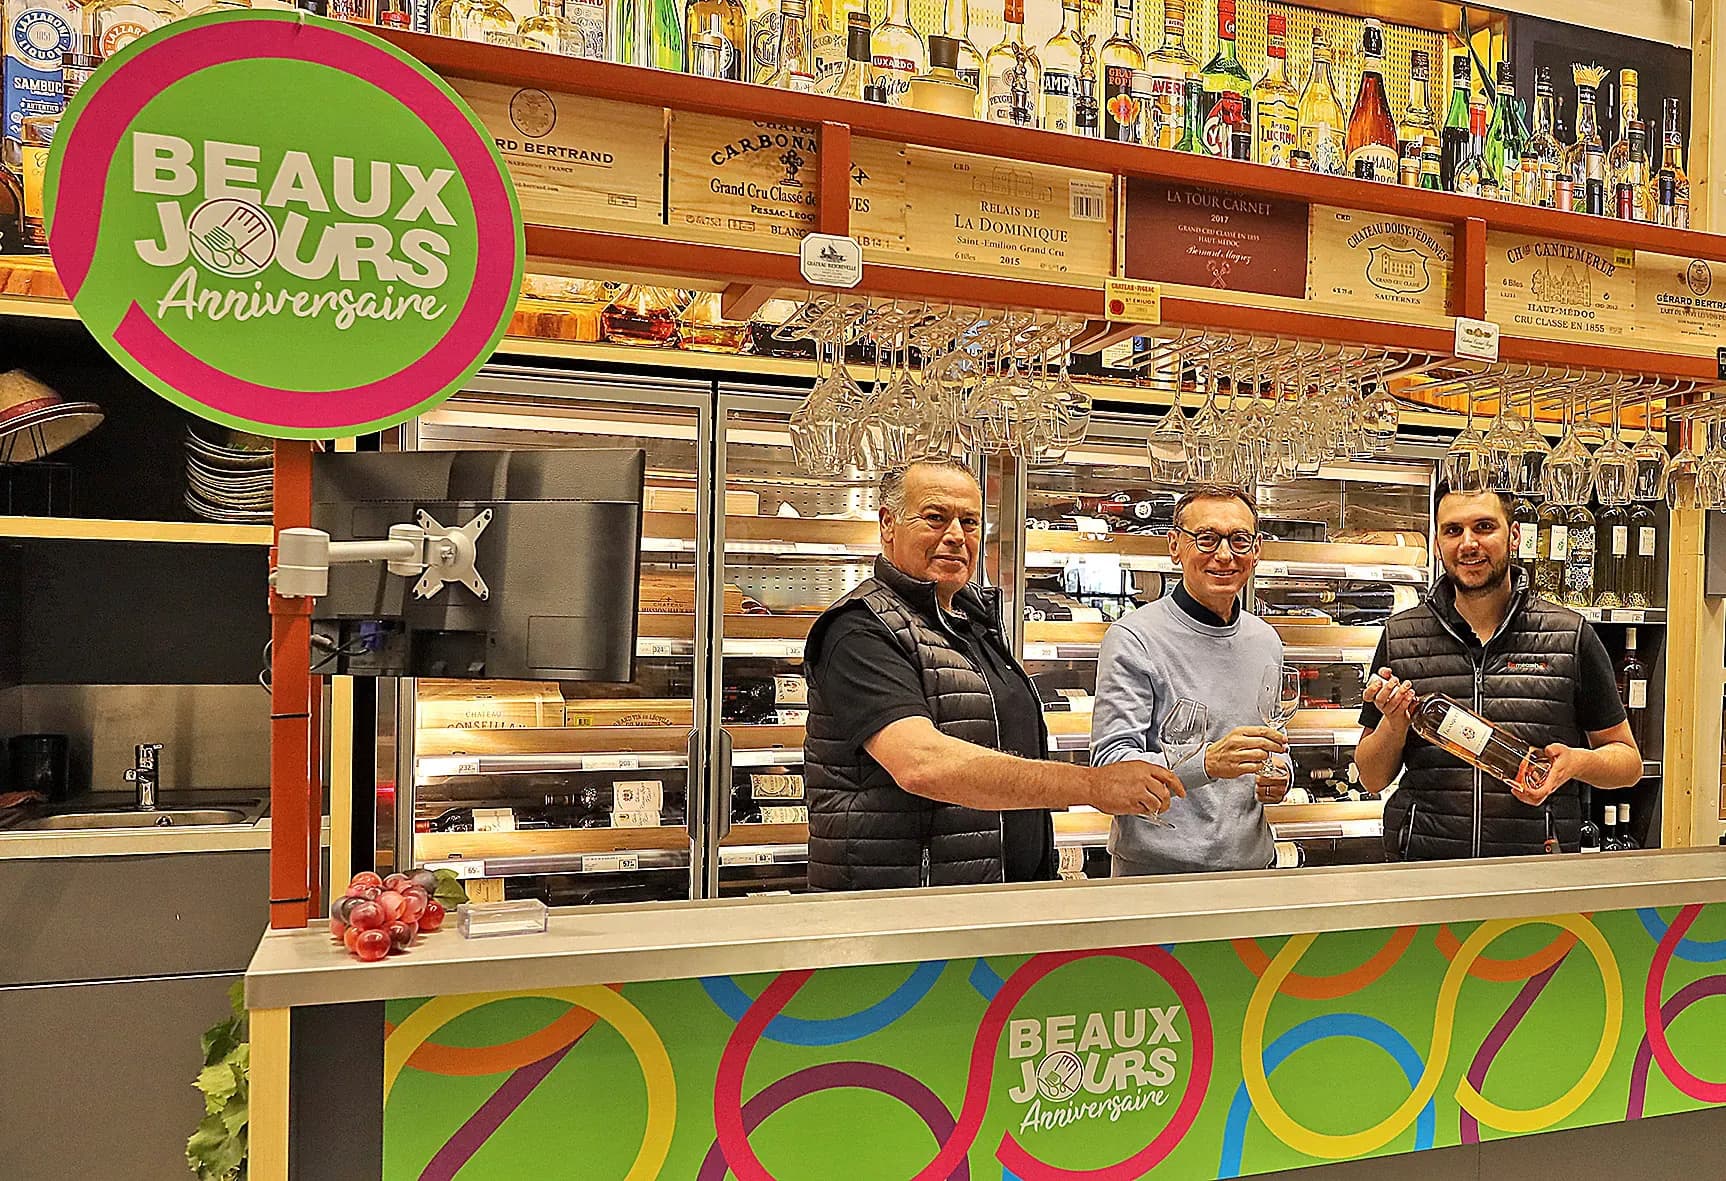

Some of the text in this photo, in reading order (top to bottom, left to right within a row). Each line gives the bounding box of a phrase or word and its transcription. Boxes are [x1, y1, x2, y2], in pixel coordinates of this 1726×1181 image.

[16, 12, 69, 41] LAZZARONI
[873, 57, 916, 71] LUXARDO
[14, 76, 64, 94] SAMBUC
[524, 143, 614, 164] BERTRAND
[133, 131, 458, 227] BEAUX
[710, 177, 745, 197] Grand
[747, 183, 769, 200] Cru
[769, 187, 803, 205] Classé
[980, 200, 1041, 219] RELAIS DE
[1167, 189, 1182, 203] LA
[1185, 192, 1221, 209] TOUR
[1222, 199, 1272, 217] CARNET
[954, 213, 1068, 244] LA DOMINIQUE
[1177, 224, 1202, 234] GRAND
[1202, 227, 1216, 236] CRU
[1210, 214, 1231, 224] 2017
[134, 198, 451, 289] JOURS
[956, 235, 979, 246] Saint
[1019, 244, 1046, 255] Grand
[1049, 248, 1065, 257] Cru
[1346, 222, 1384, 249] CHATEAU
[1000, 255, 1021, 266] 2015
[1534, 242, 1616, 278] CANTEMERLE
[157, 266, 448, 330] Anniversaire
[1375, 293, 1421, 305] SAUTERNES
[1656, 292, 1693, 306] GÉRARD
[1514, 314, 1533, 325] CRU
[1570, 321, 1583, 331] EN
[1585, 323, 1605, 333] 1855
[1009, 1005, 1182, 1059] BEAUX
[1008, 1048, 1178, 1104] JOURS
[1020, 1088, 1170, 1136] Anniversaire
